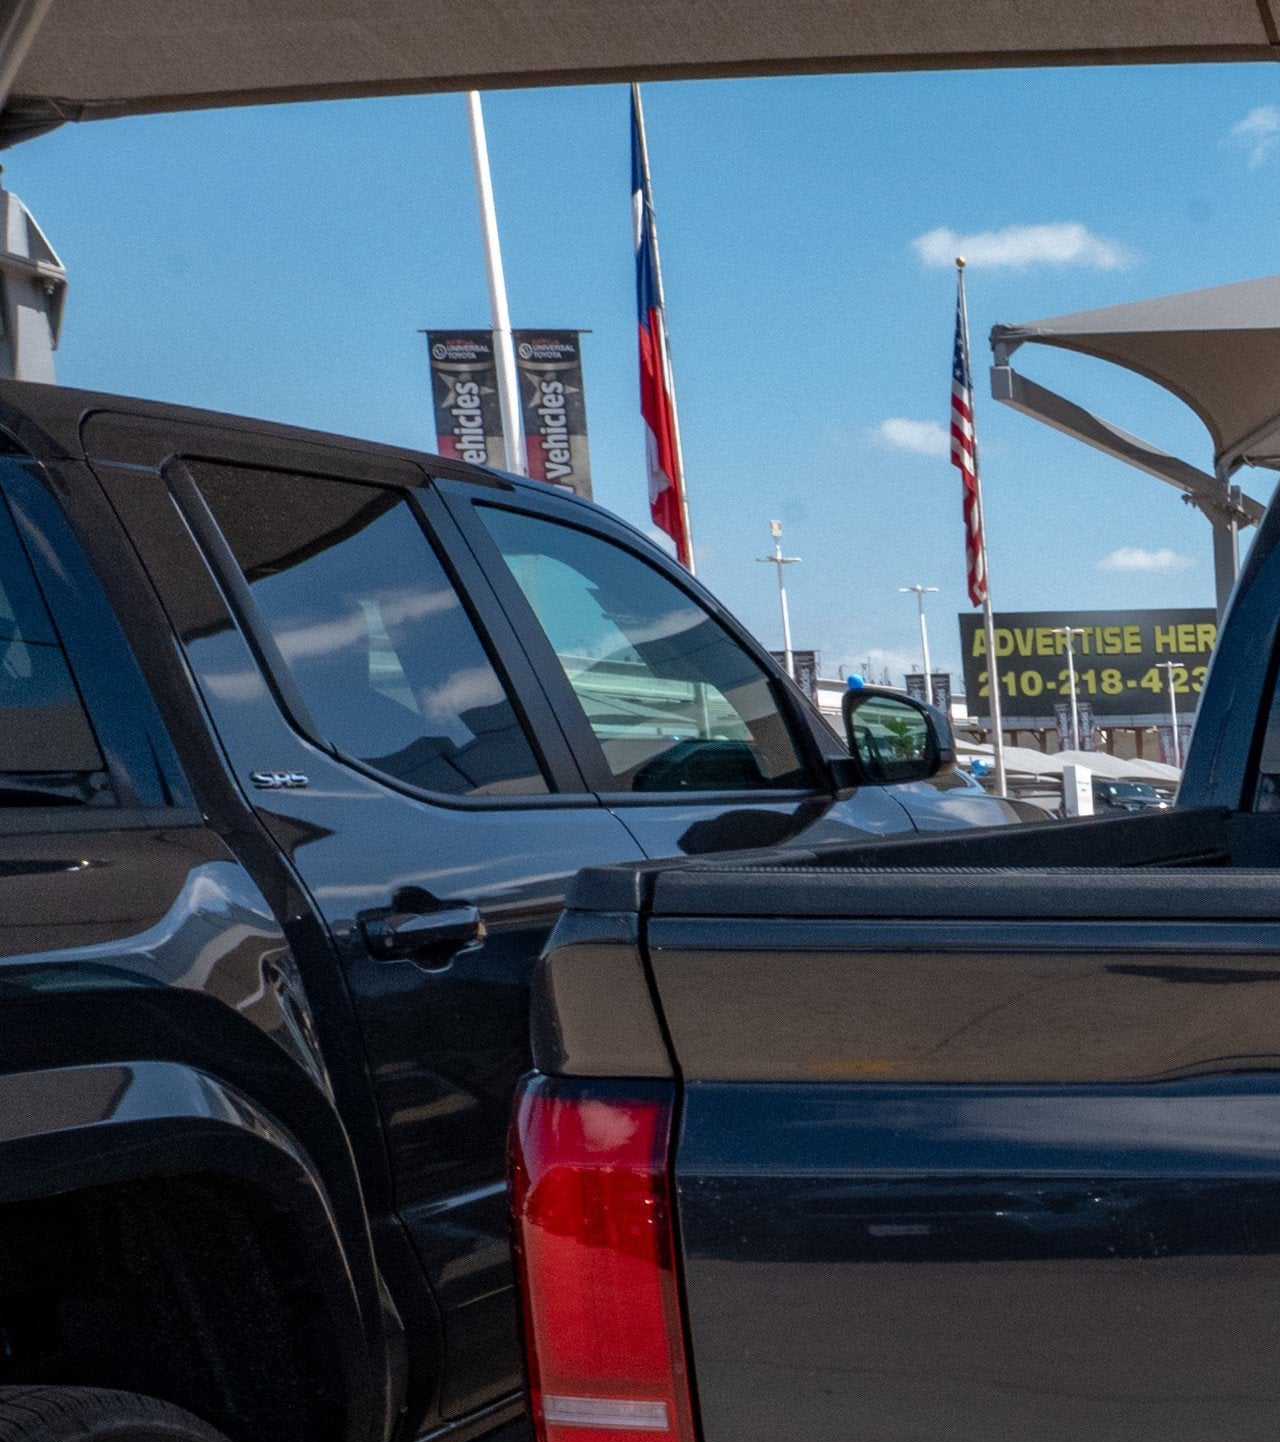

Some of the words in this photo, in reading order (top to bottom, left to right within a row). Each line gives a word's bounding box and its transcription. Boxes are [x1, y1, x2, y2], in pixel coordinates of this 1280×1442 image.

[452, 382, 487, 465] ehicles
[538, 381, 572, 480] Vehicles
[972, 625, 1142, 658] ADVERTISE
[1154, 623, 1217, 653] HER
[978, 666, 1208, 697] 210-218-423
[250, 770, 310, 789] SR5
